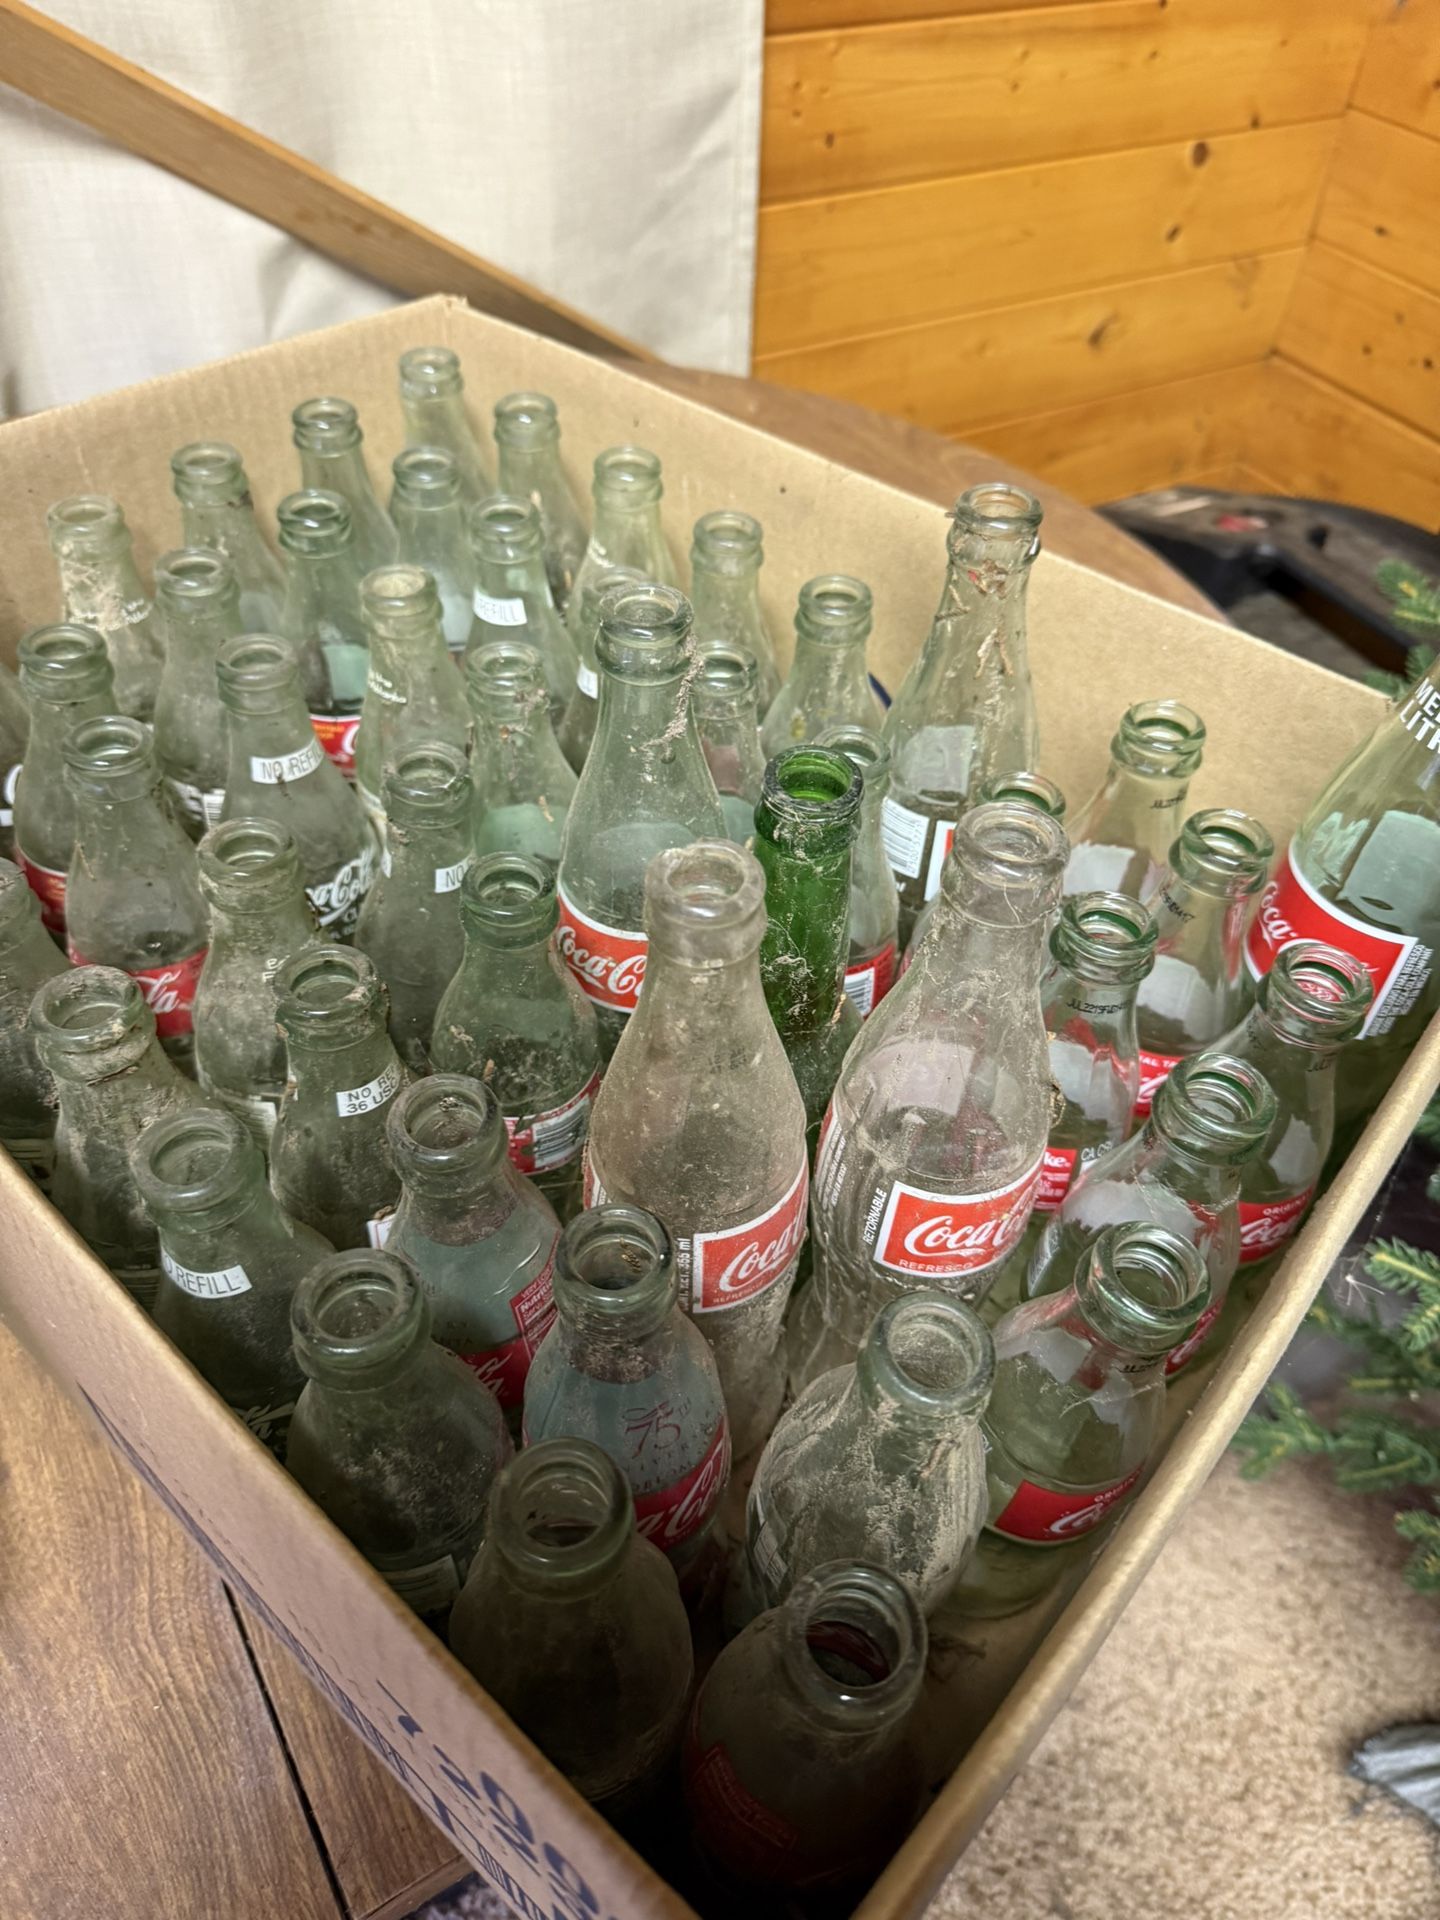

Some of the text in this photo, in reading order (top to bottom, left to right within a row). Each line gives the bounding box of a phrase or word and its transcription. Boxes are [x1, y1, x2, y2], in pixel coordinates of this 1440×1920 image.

[261, 760, 283, 781] NO
[446, 864, 464, 889] NO
[348, 1087, 372, 1102] NO
[347, 1100, 368, 1114] 36
[862, 1187, 888, 1246] RETORNABLE
[898, 1258, 974, 1274] REFRESCO
[175, 1265, 241, 1295] REFILL
